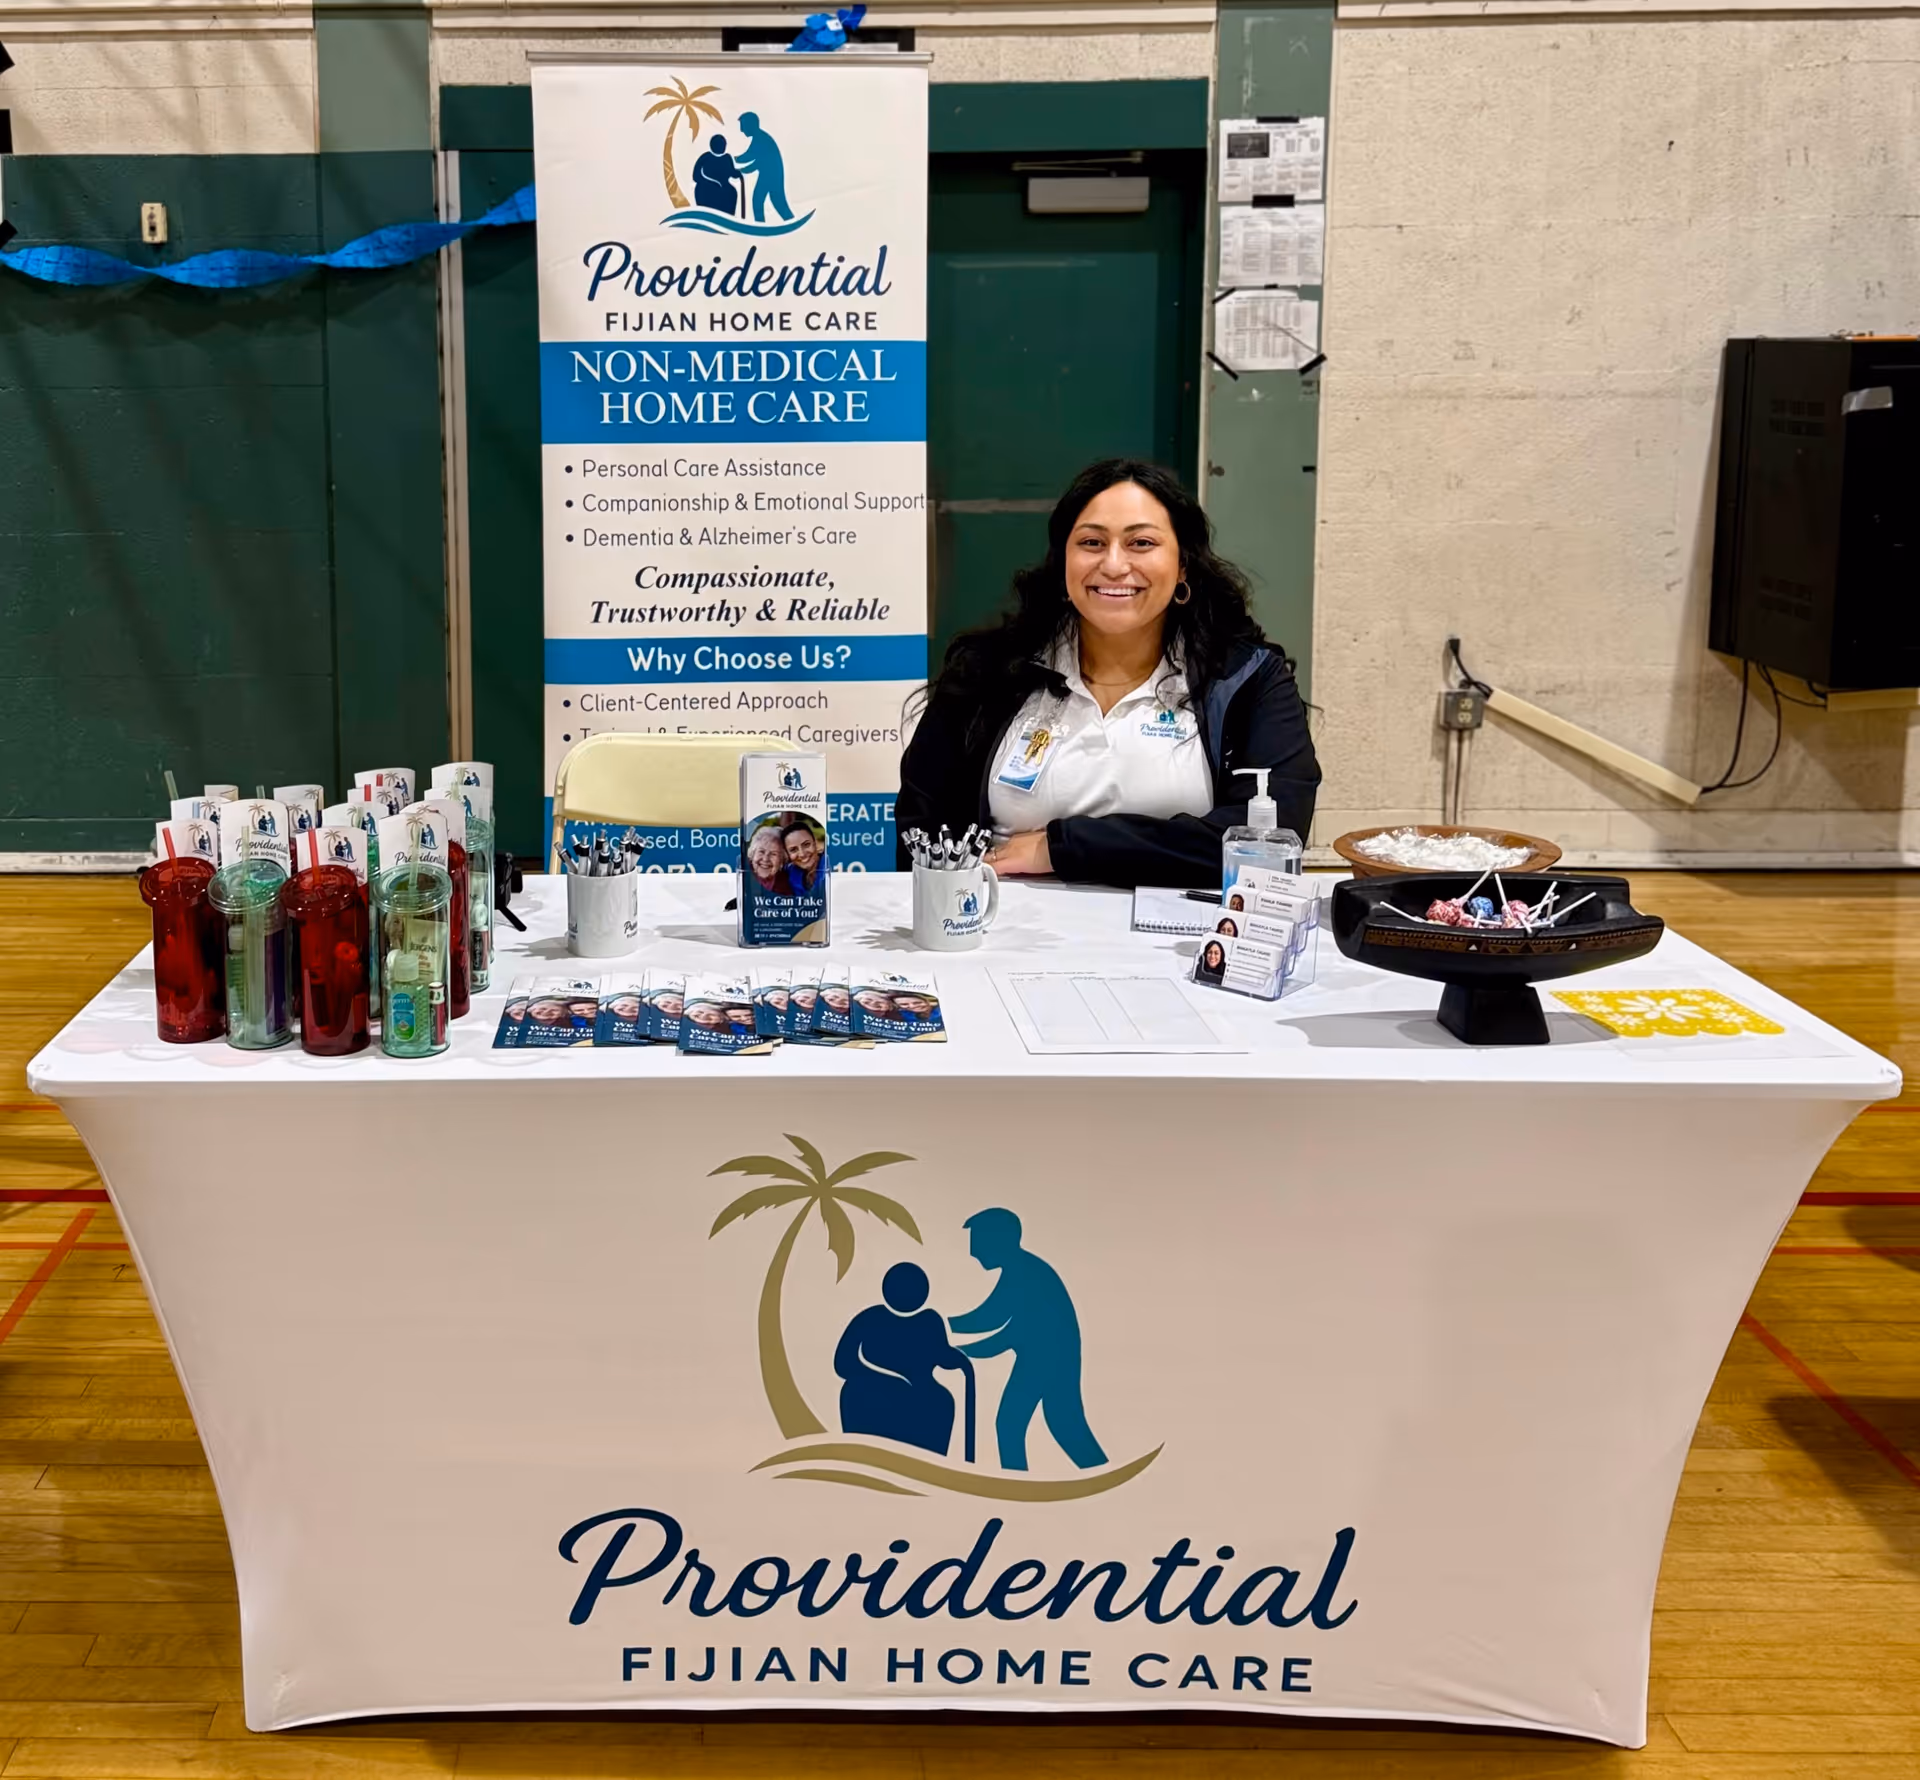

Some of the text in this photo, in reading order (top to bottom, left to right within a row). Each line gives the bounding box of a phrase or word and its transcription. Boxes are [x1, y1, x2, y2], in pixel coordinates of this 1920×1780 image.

[583, 241, 892, 301] Providential
[605, 311, 878, 332] FIJIAN HOME CARE
[569, 348, 898, 383] NON-MEDICAL
[599, 390, 871, 424] HOME CARE
[582, 458, 827, 478] Personal Care Assistance
[582, 491, 925, 515] Companionship & Emotional Support
[583, 526, 857, 547] Dementia & Alzheimer's Care
[634, 565, 836, 594] Compassionate,
[590, 597, 890, 628] Trustworthy & Reliable
[626, 644, 852, 675] Why Choose Us?
[580, 690, 829, 713] Client-Centered Approach
[797, 724, 899, 746] Caregivers
[763, 791, 821, 803] Providential
[827, 803, 895, 822] ERATE
[690, 829, 741, 849] Bond
[826, 827, 884, 846] sured
[753, 907, 818, 918] Care of You!
[754, 896, 823, 906] We Can Take
[558, 1507, 1359, 1631] Providential
[622, 1647, 1314, 1694] FIJIAN HOME CARE
